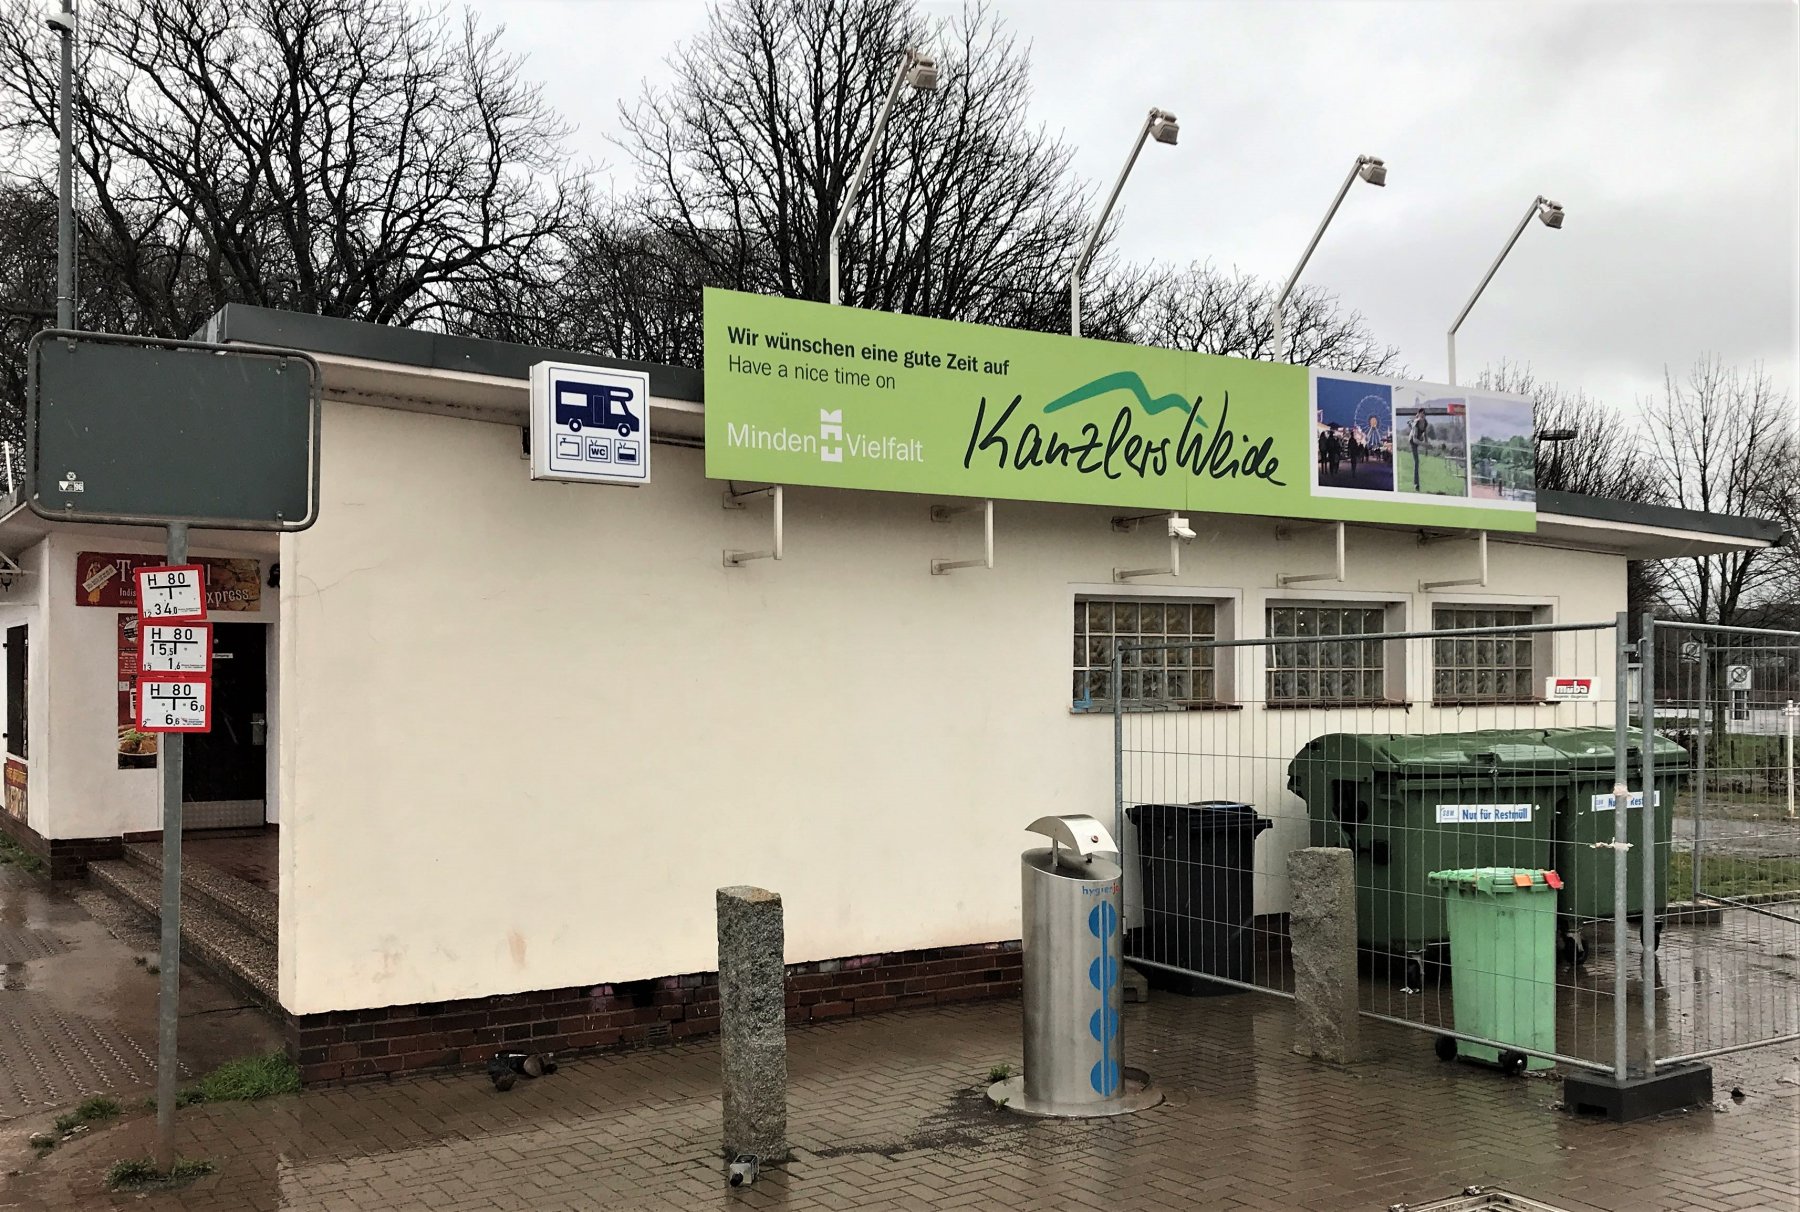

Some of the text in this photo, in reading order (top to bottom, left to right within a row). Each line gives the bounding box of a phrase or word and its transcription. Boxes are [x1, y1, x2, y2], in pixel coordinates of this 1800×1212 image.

[728, 326, 1010, 376] Wir wünschen eine gute Zeit auf
[729, 354, 896, 390] Have a nice time on
[727, 422, 924, 463] Minden Vielfalt
[591, 447, 606, 456] WC
[148, 572, 185, 586] H 80
[206, 589, 249, 607] xpress
[152, 628, 193, 640] H 80
[150, 684, 191, 696] H 80
[1462, 809, 1477, 820] Nur
[1480, 808, 1492, 820] für
[1495, 808, 1528, 819] Restmüll
